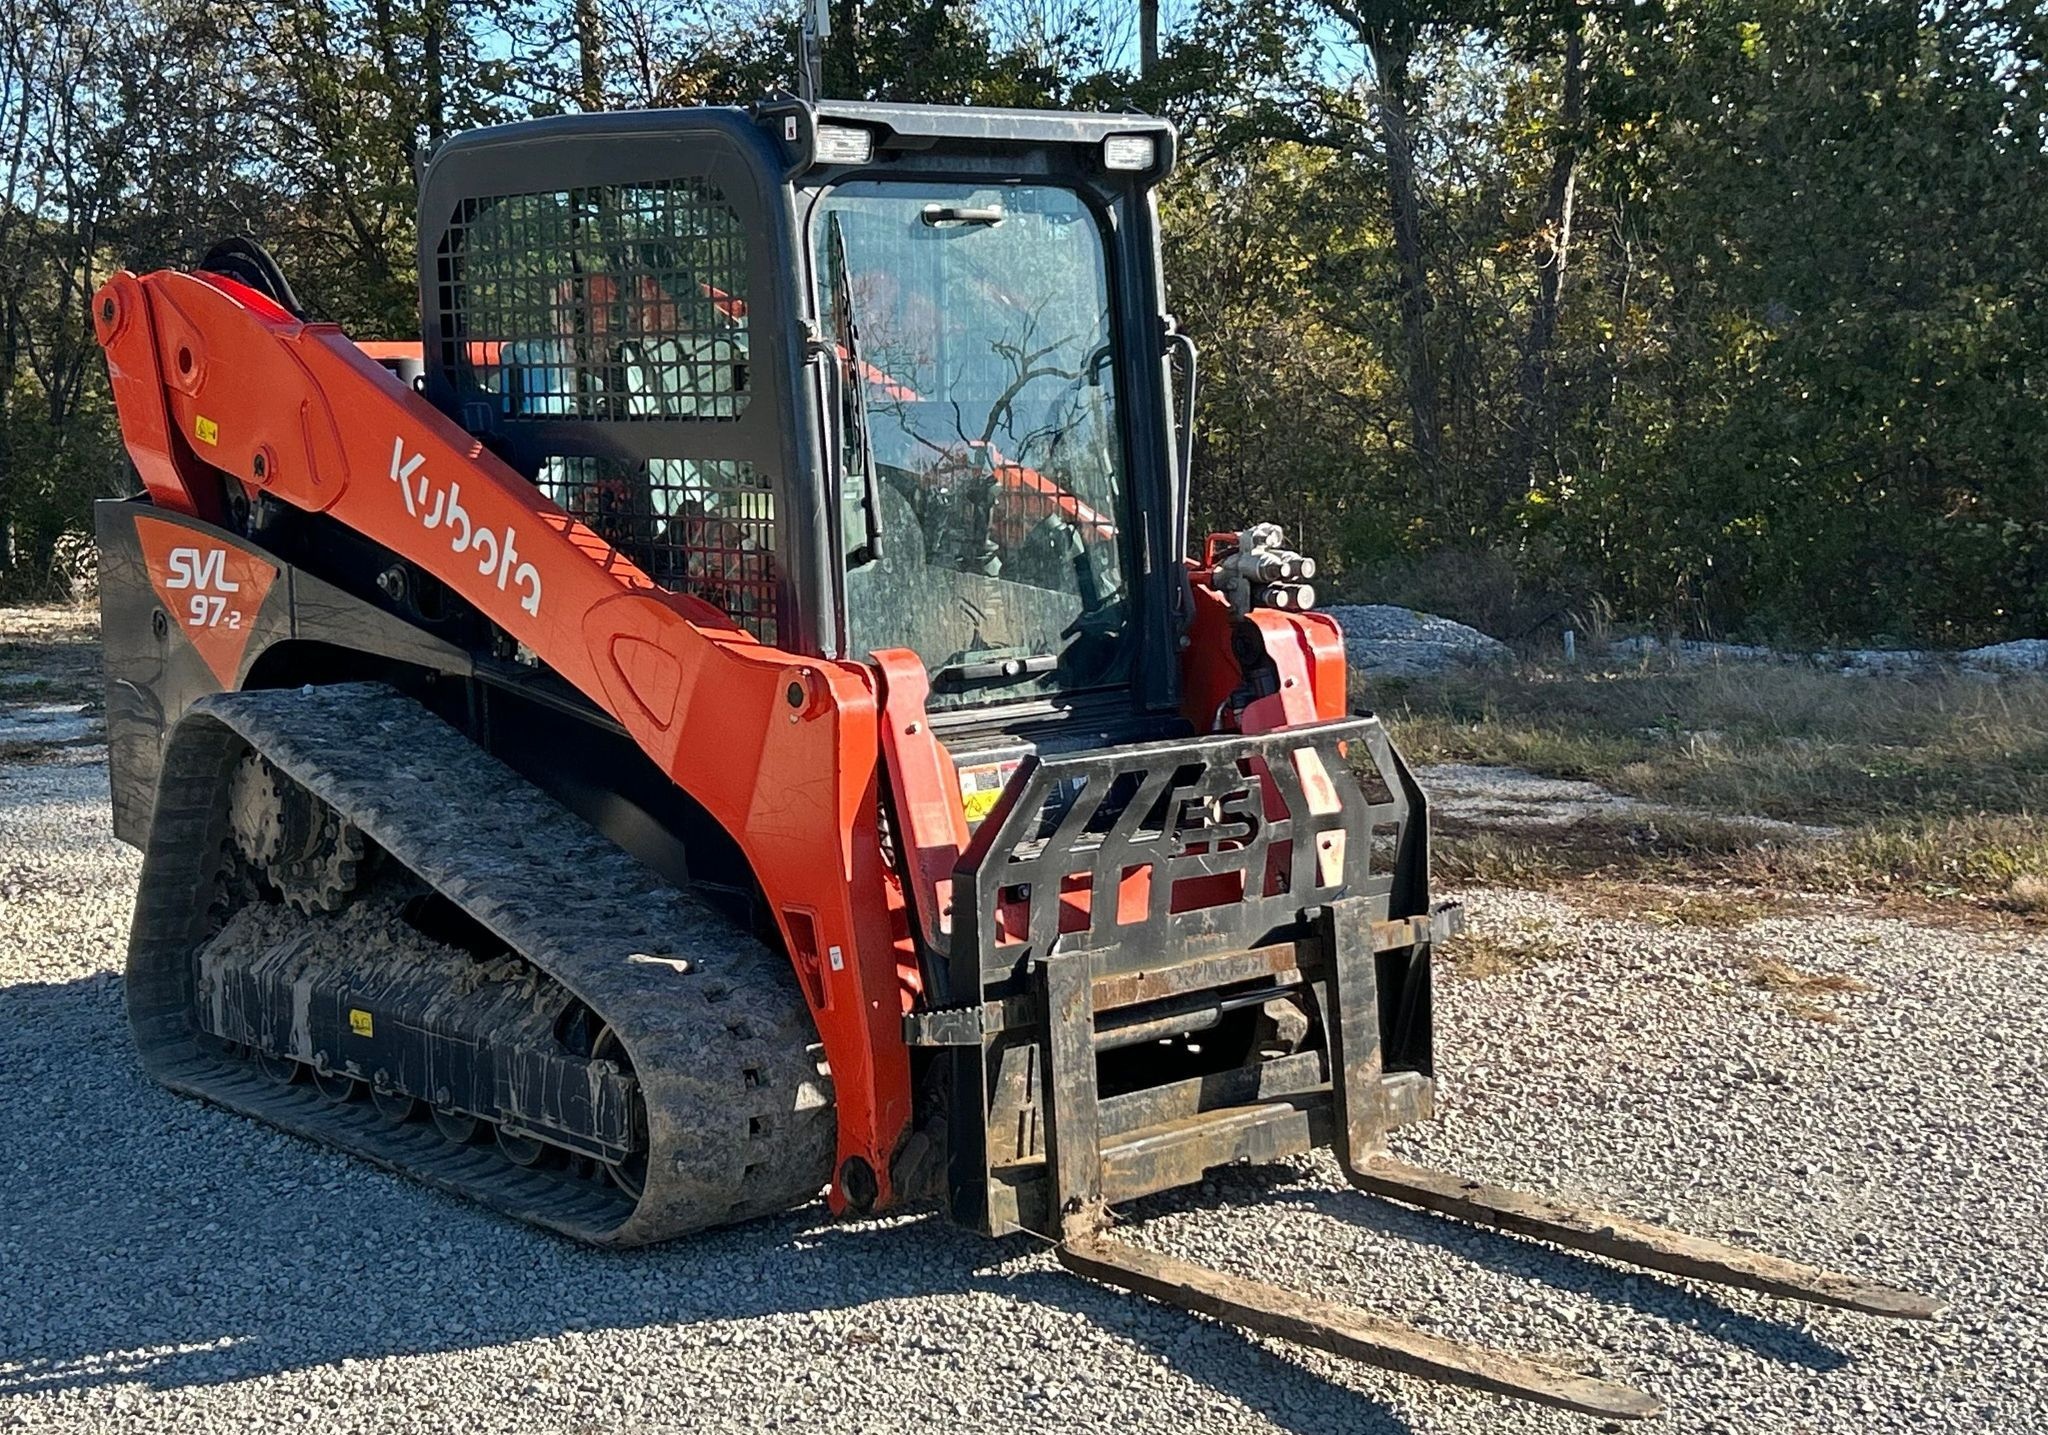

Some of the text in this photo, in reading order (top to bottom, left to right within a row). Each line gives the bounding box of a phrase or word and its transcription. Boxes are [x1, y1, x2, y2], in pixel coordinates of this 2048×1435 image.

[390, 435, 542, 618] Kubota
[166, 547, 239, 592] SVL
[1167, 789, 1259, 859] ES
